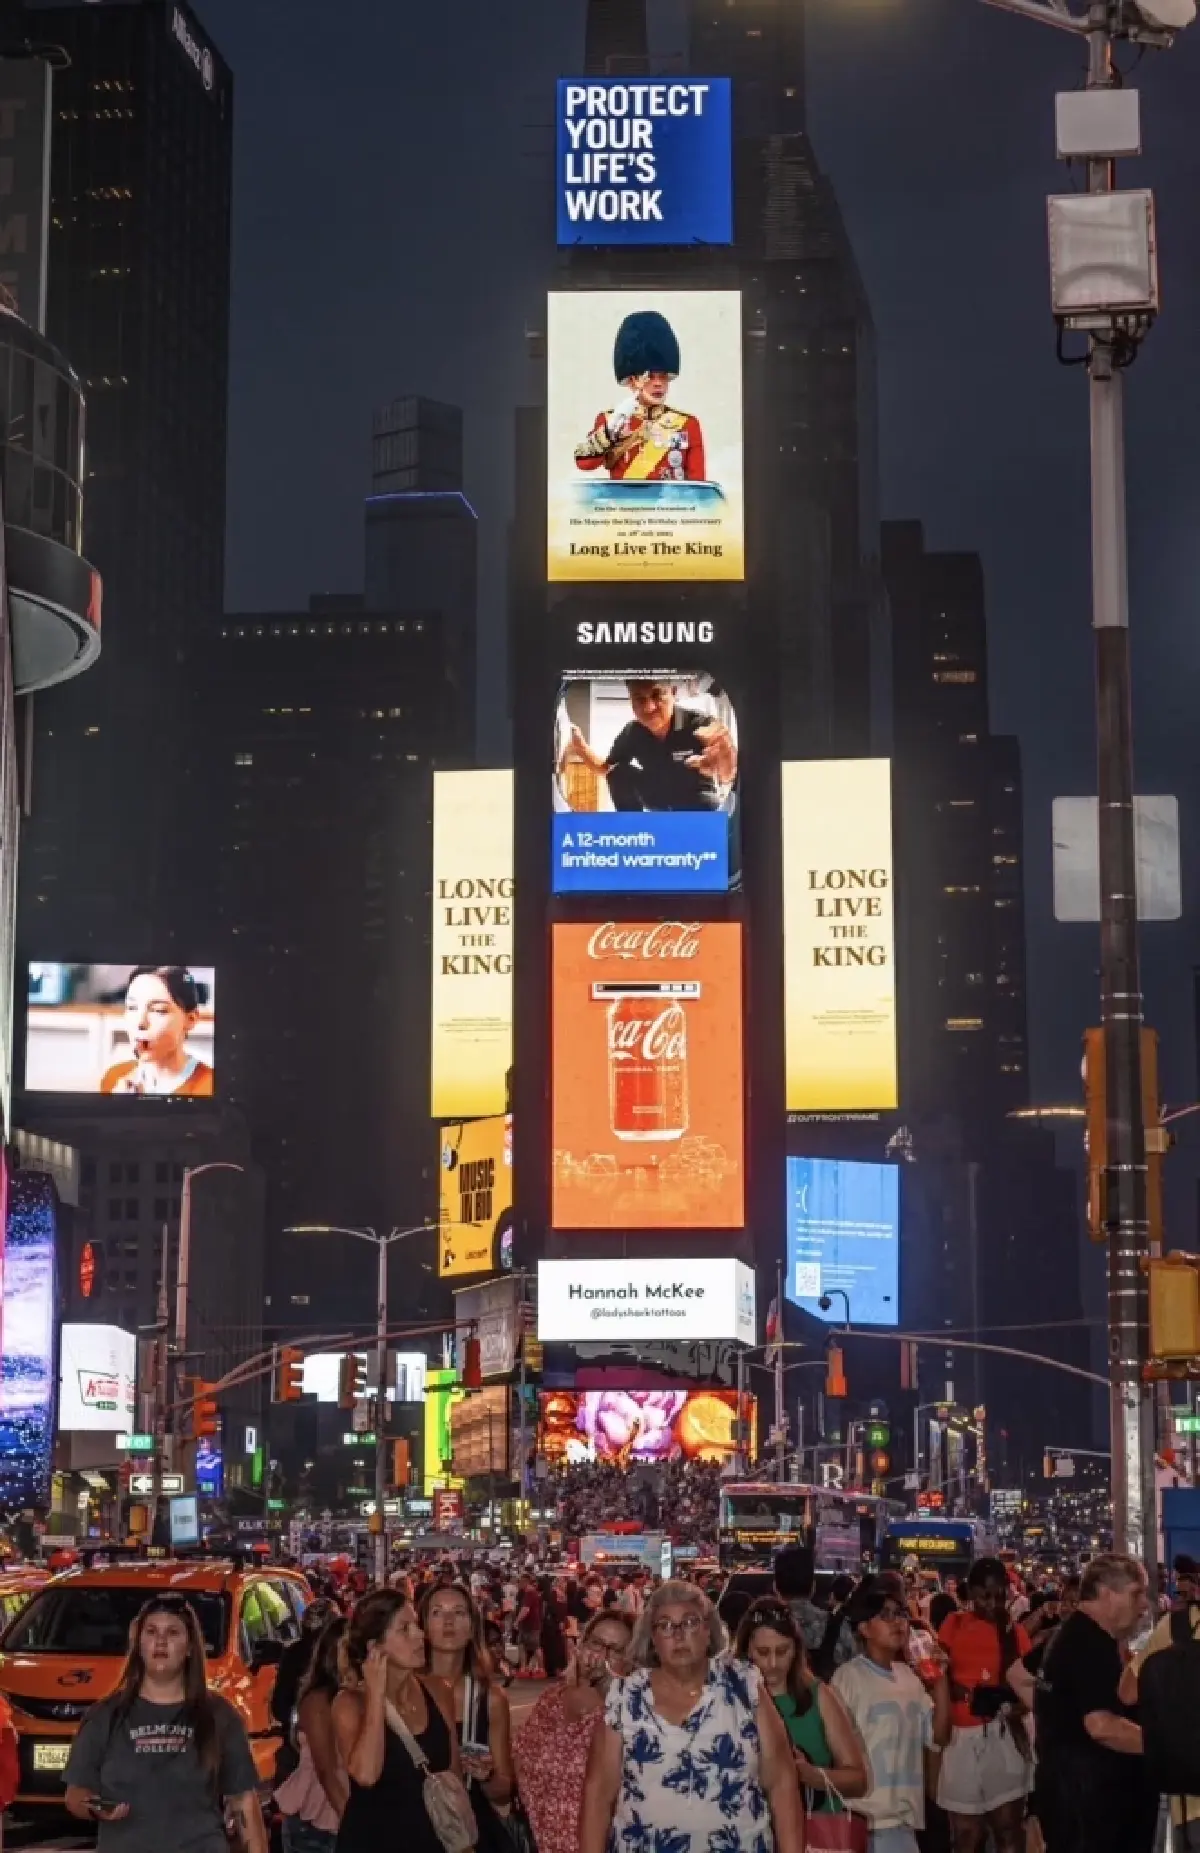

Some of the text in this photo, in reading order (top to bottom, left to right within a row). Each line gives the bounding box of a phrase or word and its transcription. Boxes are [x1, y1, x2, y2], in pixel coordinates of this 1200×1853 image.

[566, 85, 708, 116] PROTECT
[564, 118, 653, 149] YOUR
[565, 153, 656, 184] LIFE'S
[565, 190, 664, 221] WORK
[569, 541, 723, 557] Long Live The King
[576, 621, 714, 644] SAMSUNG
[562, 831, 655, 847] A 12-month
[562, 851, 619, 868] limited
[438, 878, 516, 899] LONG
[807, 869, 889, 890] LONG
[444, 906, 510, 926] LIVE
[815, 897, 882, 918] LIVE
[458, 934, 496, 947] THE
[587, 921, 702, 959] Coca-Cola
[829, 925, 868, 938] THE
[441, 954, 514, 975] KING
[812, 945, 887, 967] KING
[568, 1282, 705, 1300] Hannah McKee
